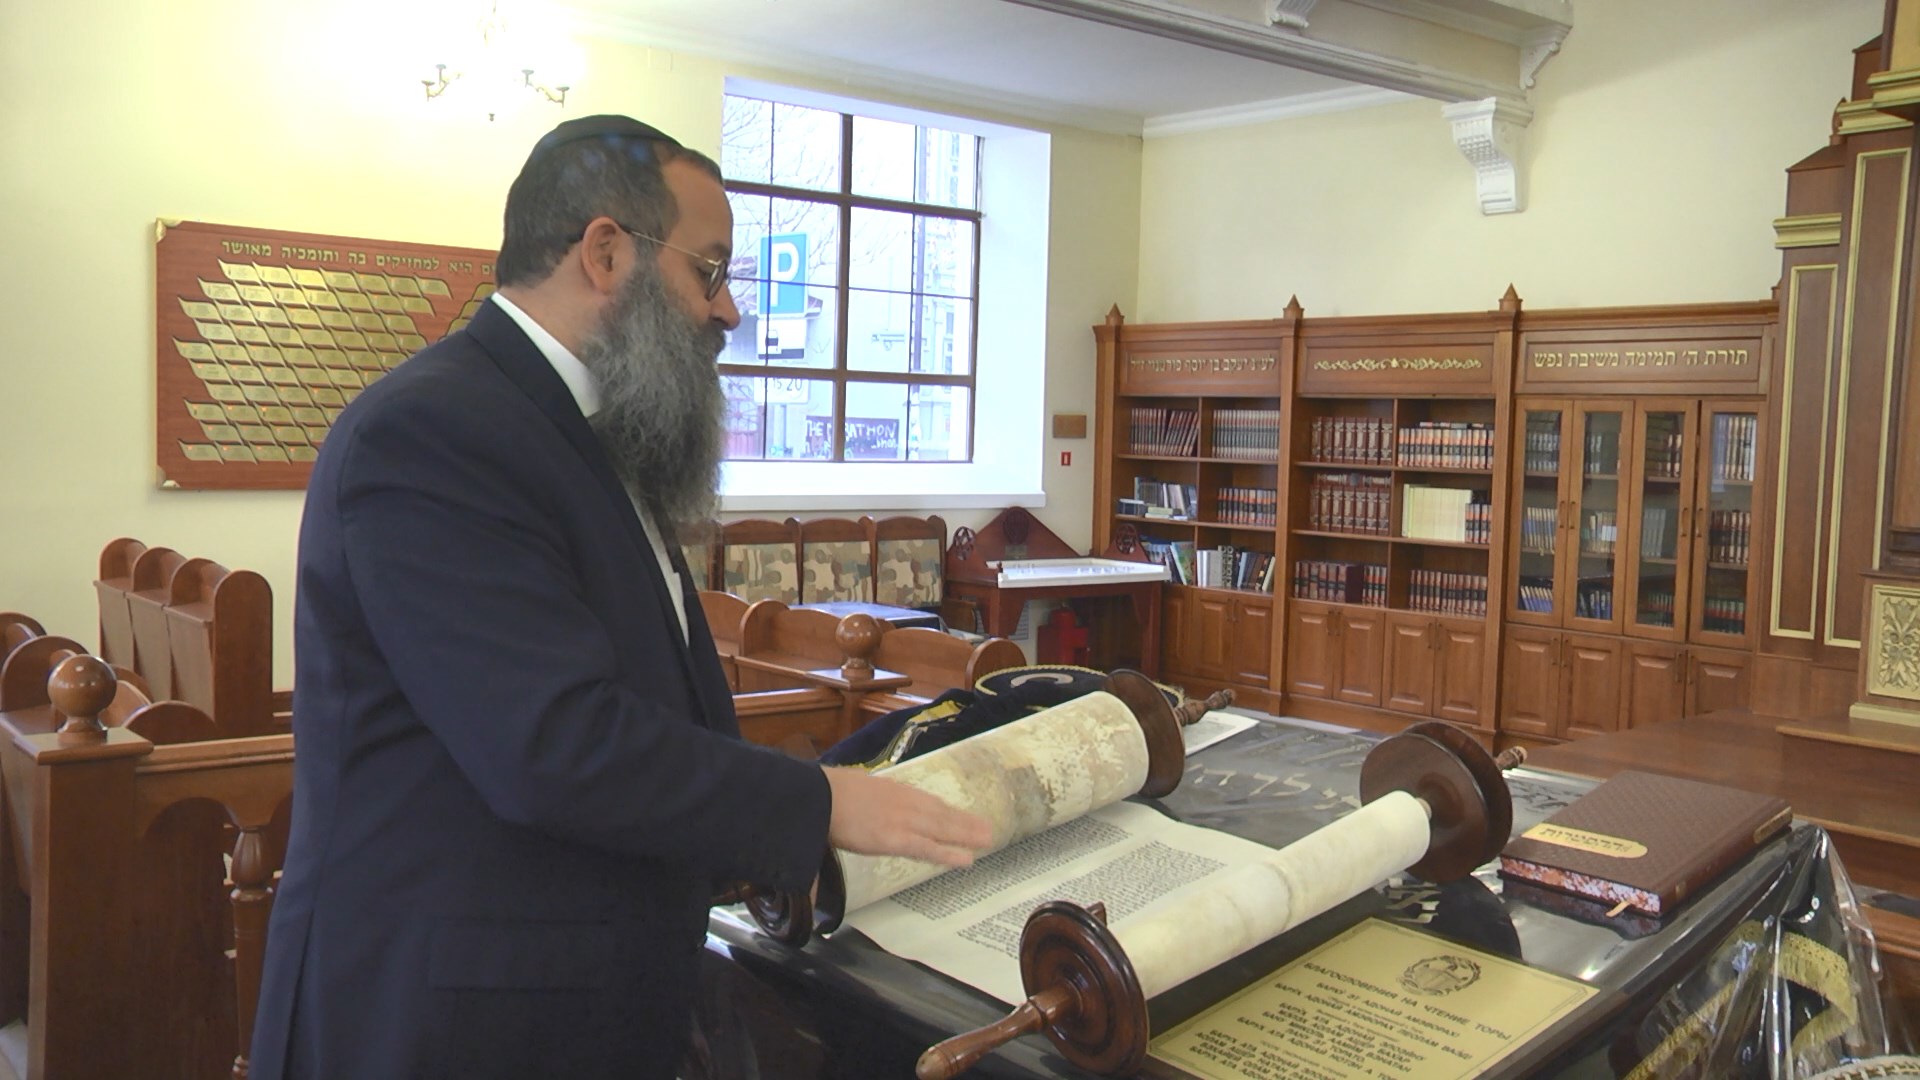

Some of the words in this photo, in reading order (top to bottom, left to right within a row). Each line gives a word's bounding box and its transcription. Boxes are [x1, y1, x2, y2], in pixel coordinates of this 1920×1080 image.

[222, 241, 272, 257] מאושר
[348, 252, 366, 265] בה
[376, 254, 440, 270] למחזיקים
[449, 261, 473, 273] היא
[771, 242, 799, 307] P
[1534, 352, 1563, 368] נפש
[1567, 351, 1619, 367] משיבת
[1625, 351, 1676, 367] תמימה
[1703, 350, 1748, 367] תורת
[1304, 963, 1397, 997] БЛАГОСЛОВЕНИЯ
[1422, 1005, 1469, 1023] ЧТЕНИЕ
[1475, 1024, 1511, 1039] ТОРЫ
[1313, 1015, 1330, 1024] АТА
[1268, 1028, 1286, 1038] АТА
[1240, 1042, 1258, 1052] АТА
[1219, 1058, 1239, 1069] АТА
